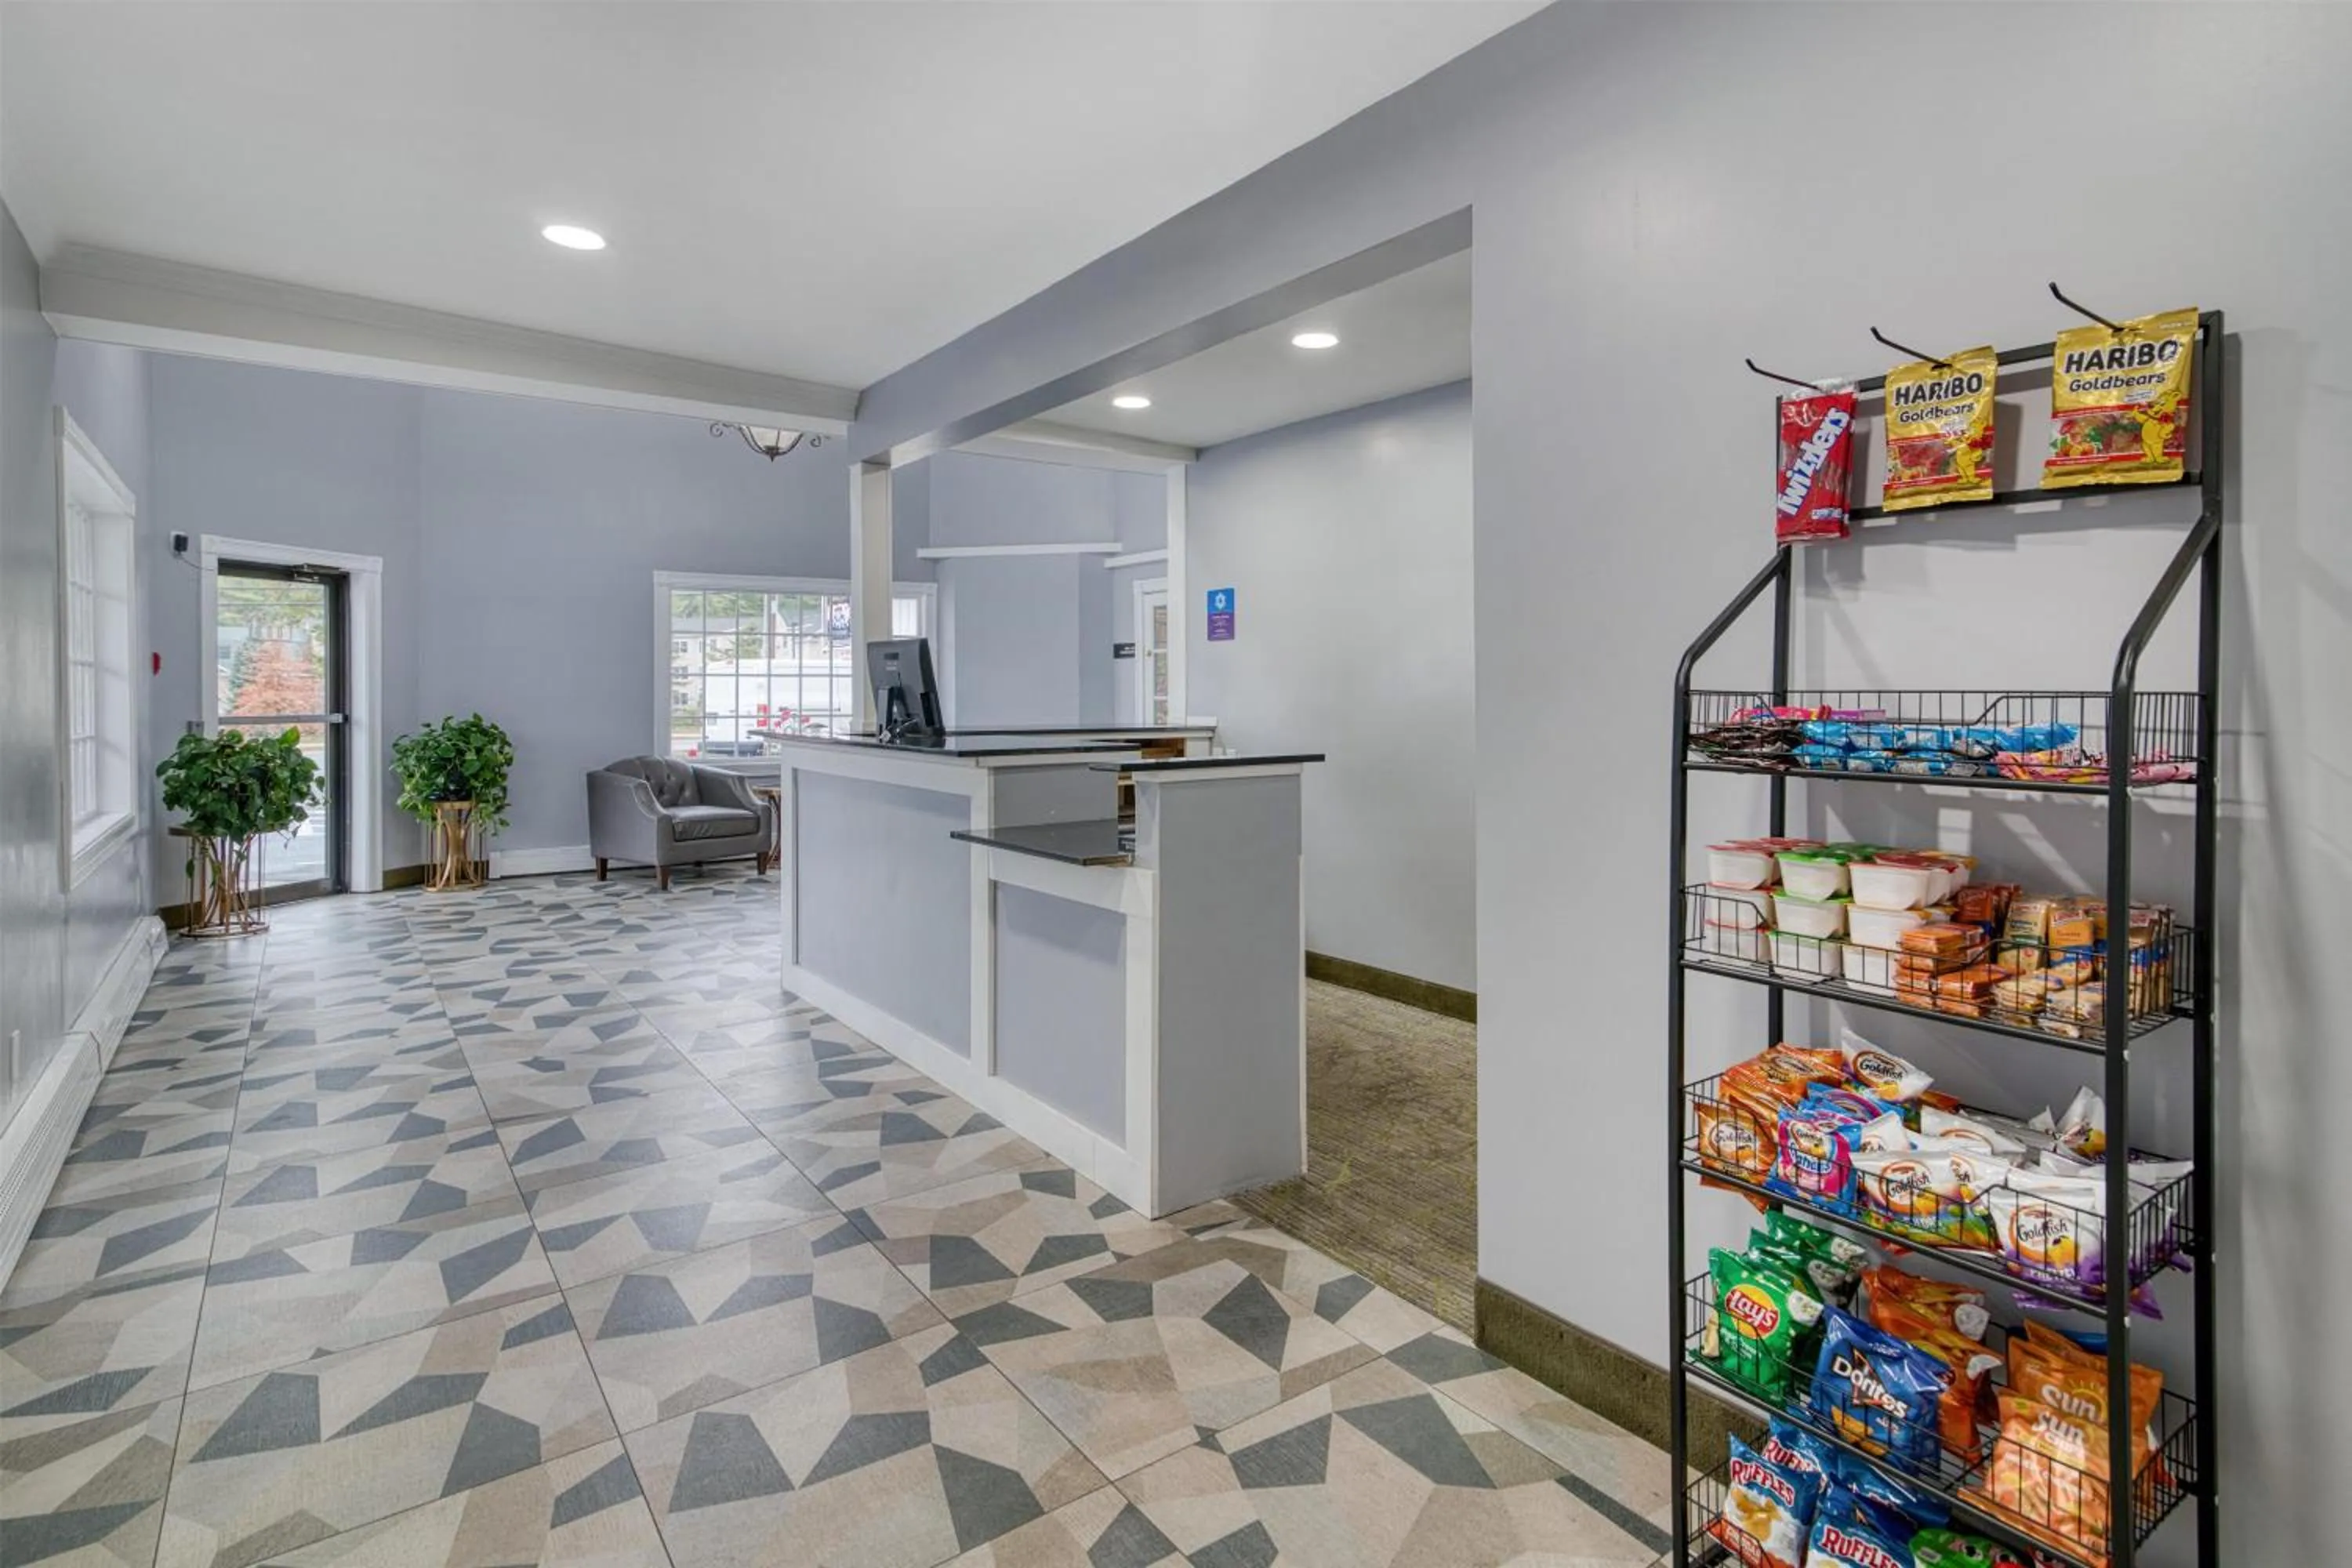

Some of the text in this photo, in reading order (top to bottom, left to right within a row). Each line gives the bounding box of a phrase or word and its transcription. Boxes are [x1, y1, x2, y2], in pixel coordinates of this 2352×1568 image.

[2064, 339, 2179, 374] HARIBO
[1894, 372, 1984, 406] HARIBO
[2069, 372, 2166, 393] Goldbears
[1900, 402, 1975, 423] Goldbears
[1859, 1057, 1904, 1081] Goldfish
[2017, 1218, 2070, 1243] Goldfish
[1832, 1356, 1909, 1419] Doritos
[1762, 1436, 1820, 1474] RUFF
[1730, 1457, 1795, 1508] RUFFLES
